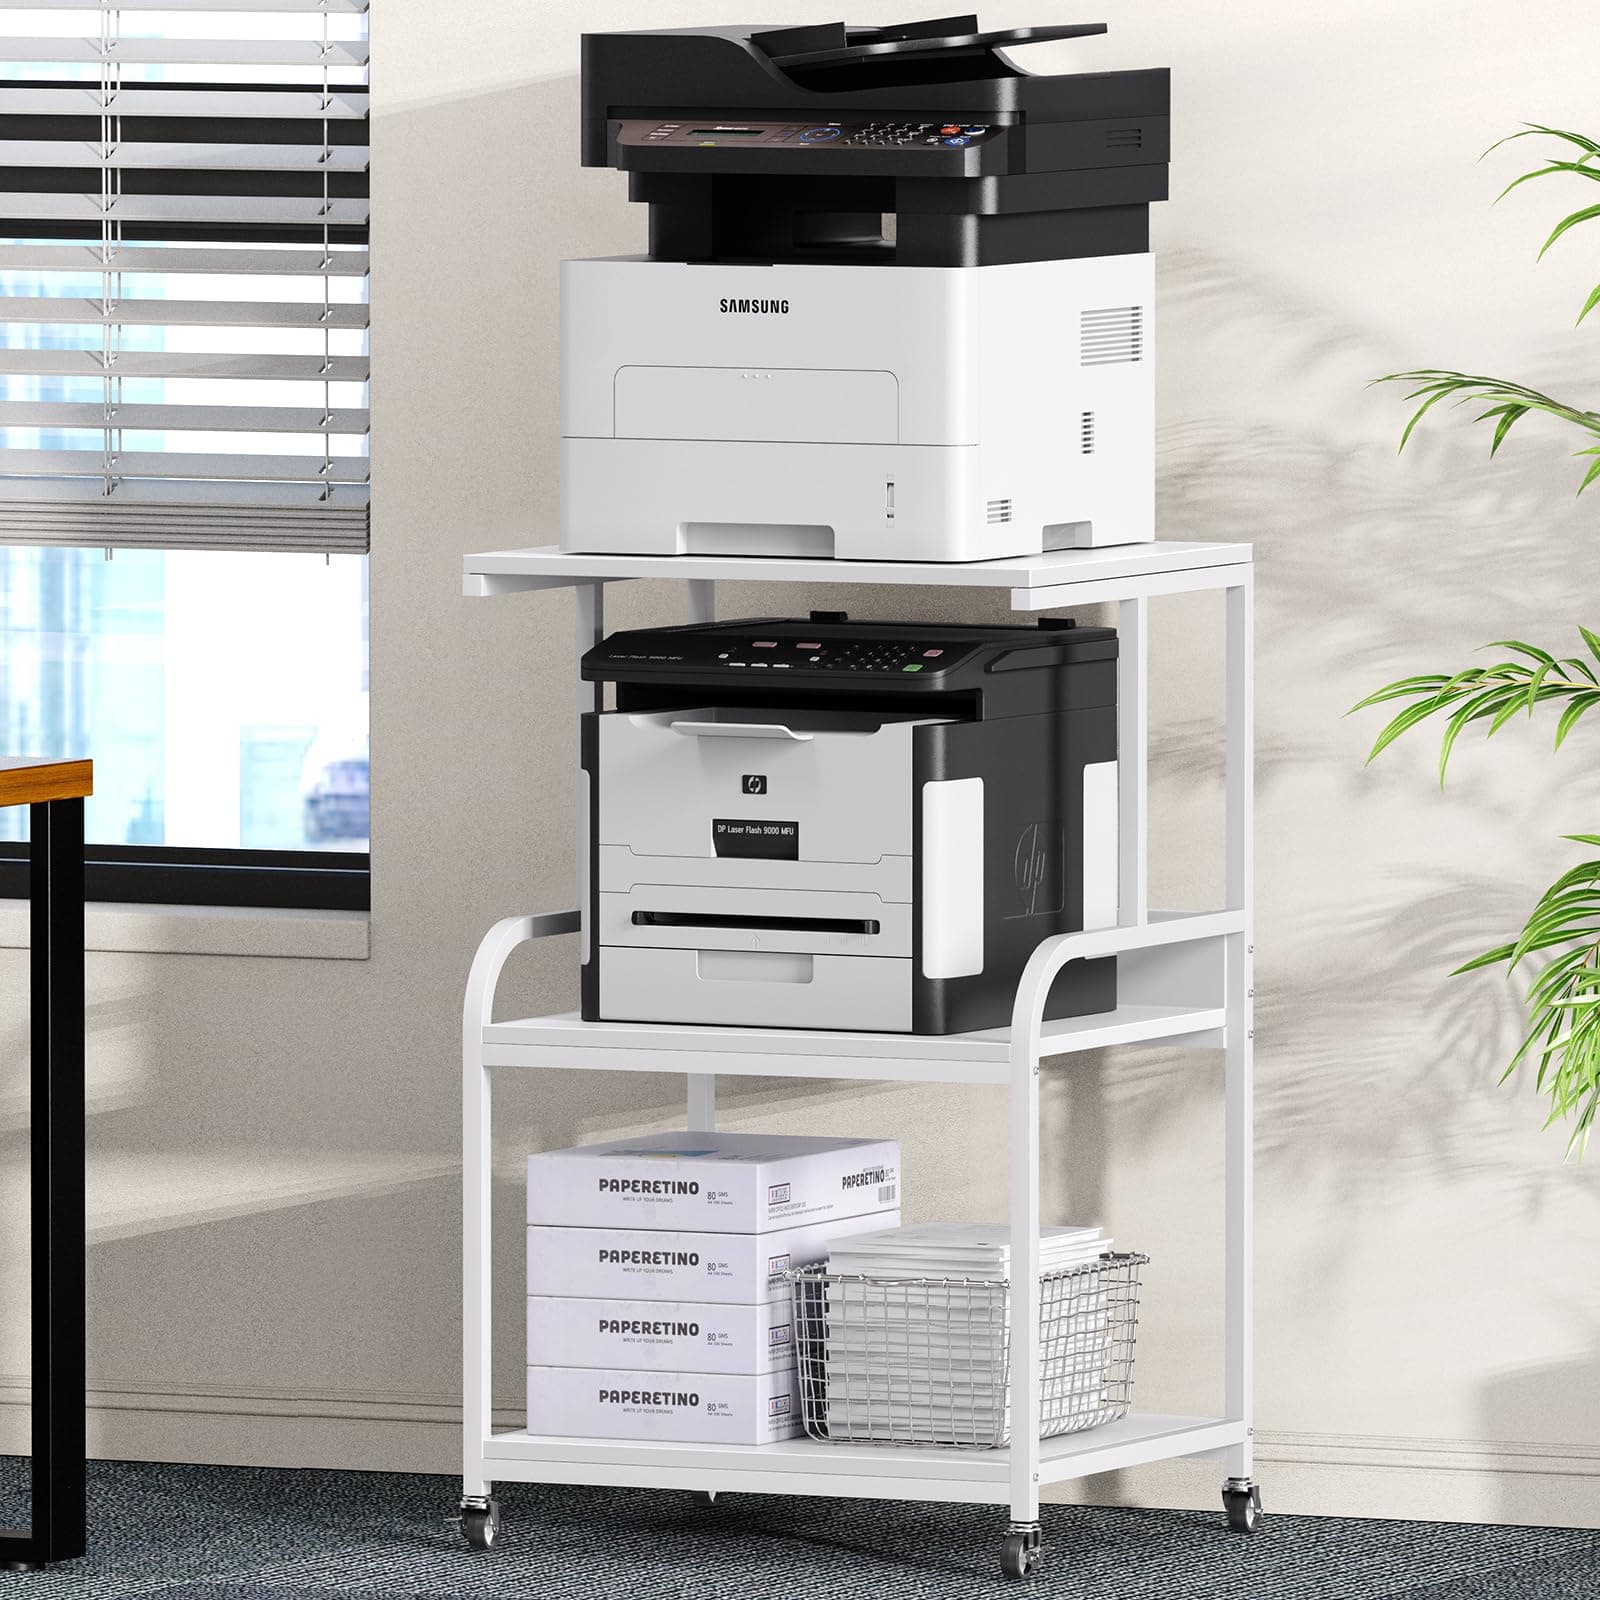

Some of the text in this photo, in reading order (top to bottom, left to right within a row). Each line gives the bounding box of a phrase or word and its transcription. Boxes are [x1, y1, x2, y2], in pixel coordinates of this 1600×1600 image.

[720, 298, 789, 314] SAMSUNG
[717, 824, 794, 836] DP Laser Flash 9000 MFU
[599, 1178, 699, 1195] PAPERETINO
[842, 1169, 885, 1190] PAPERETINO
[707, 1192, 716, 1200] 80
[599, 1249, 699, 1266] PAPERETINO
[707, 1263, 716, 1272] 80
[599, 1319, 699, 1336] PAPERETINO
[707, 1333, 716, 1342] 80
[599, 1390, 699, 1406] PAPERETINO
[707, 1403, 716, 1412] 80
